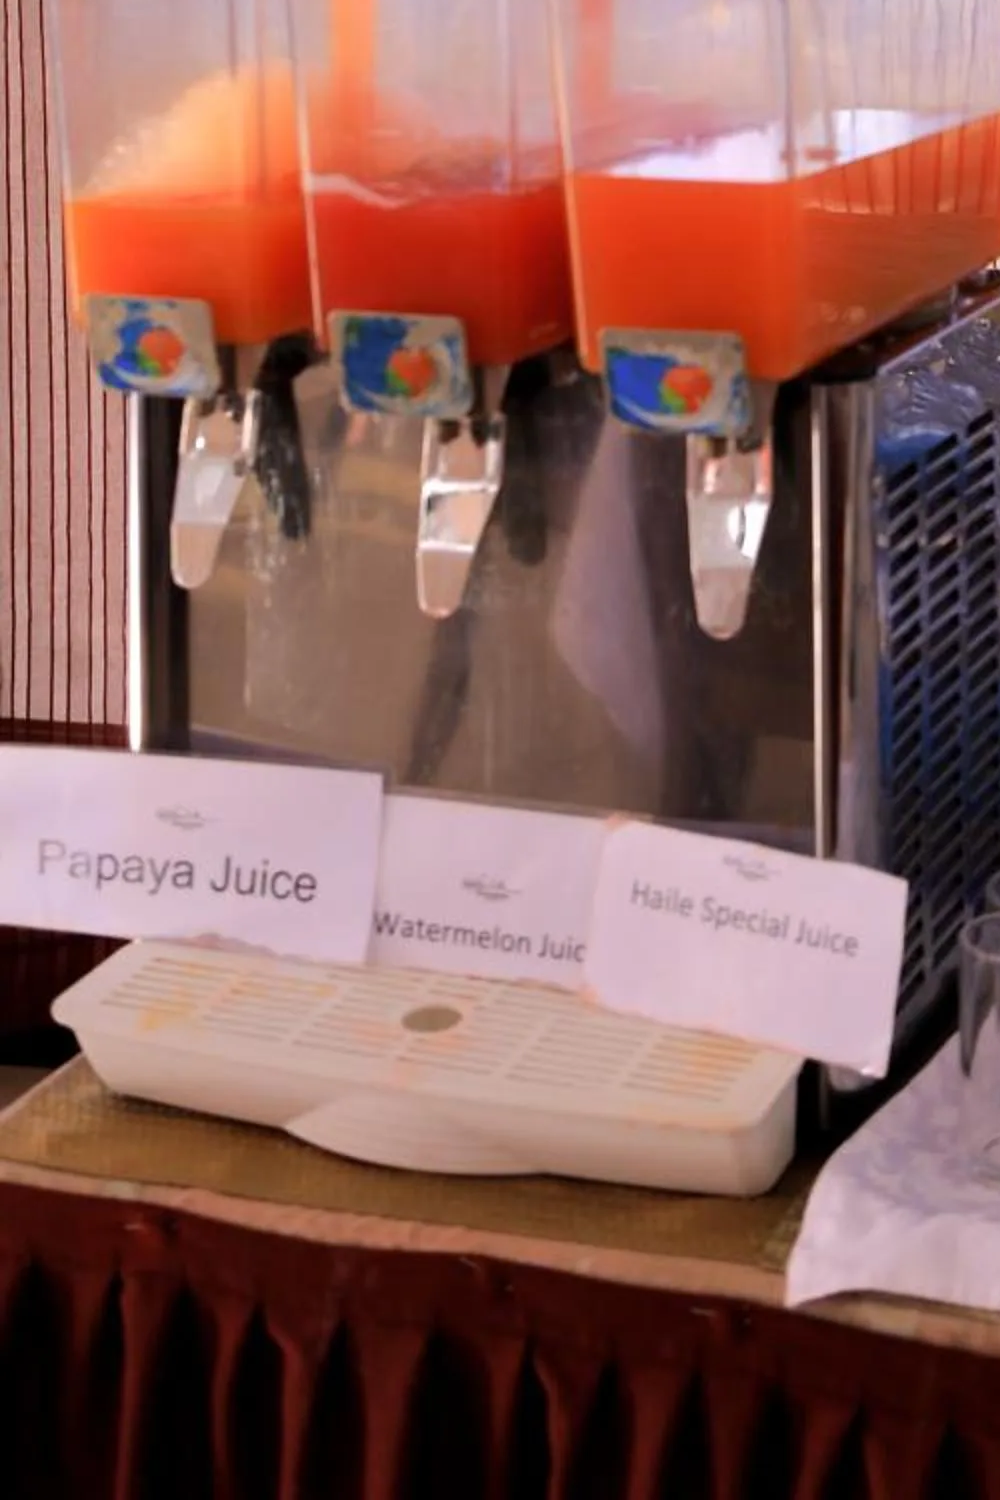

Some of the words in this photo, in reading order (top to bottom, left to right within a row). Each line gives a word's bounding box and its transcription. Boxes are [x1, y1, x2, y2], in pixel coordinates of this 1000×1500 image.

[36, 838, 195, 895] Papaya
[209, 855, 318, 902] Juice
[373, 911, 532, 954] Watermelon
[537, 933, 588, 963] Juic
[700, 896, 791, 941] Special
[795, 916, 860, 958] Juice
